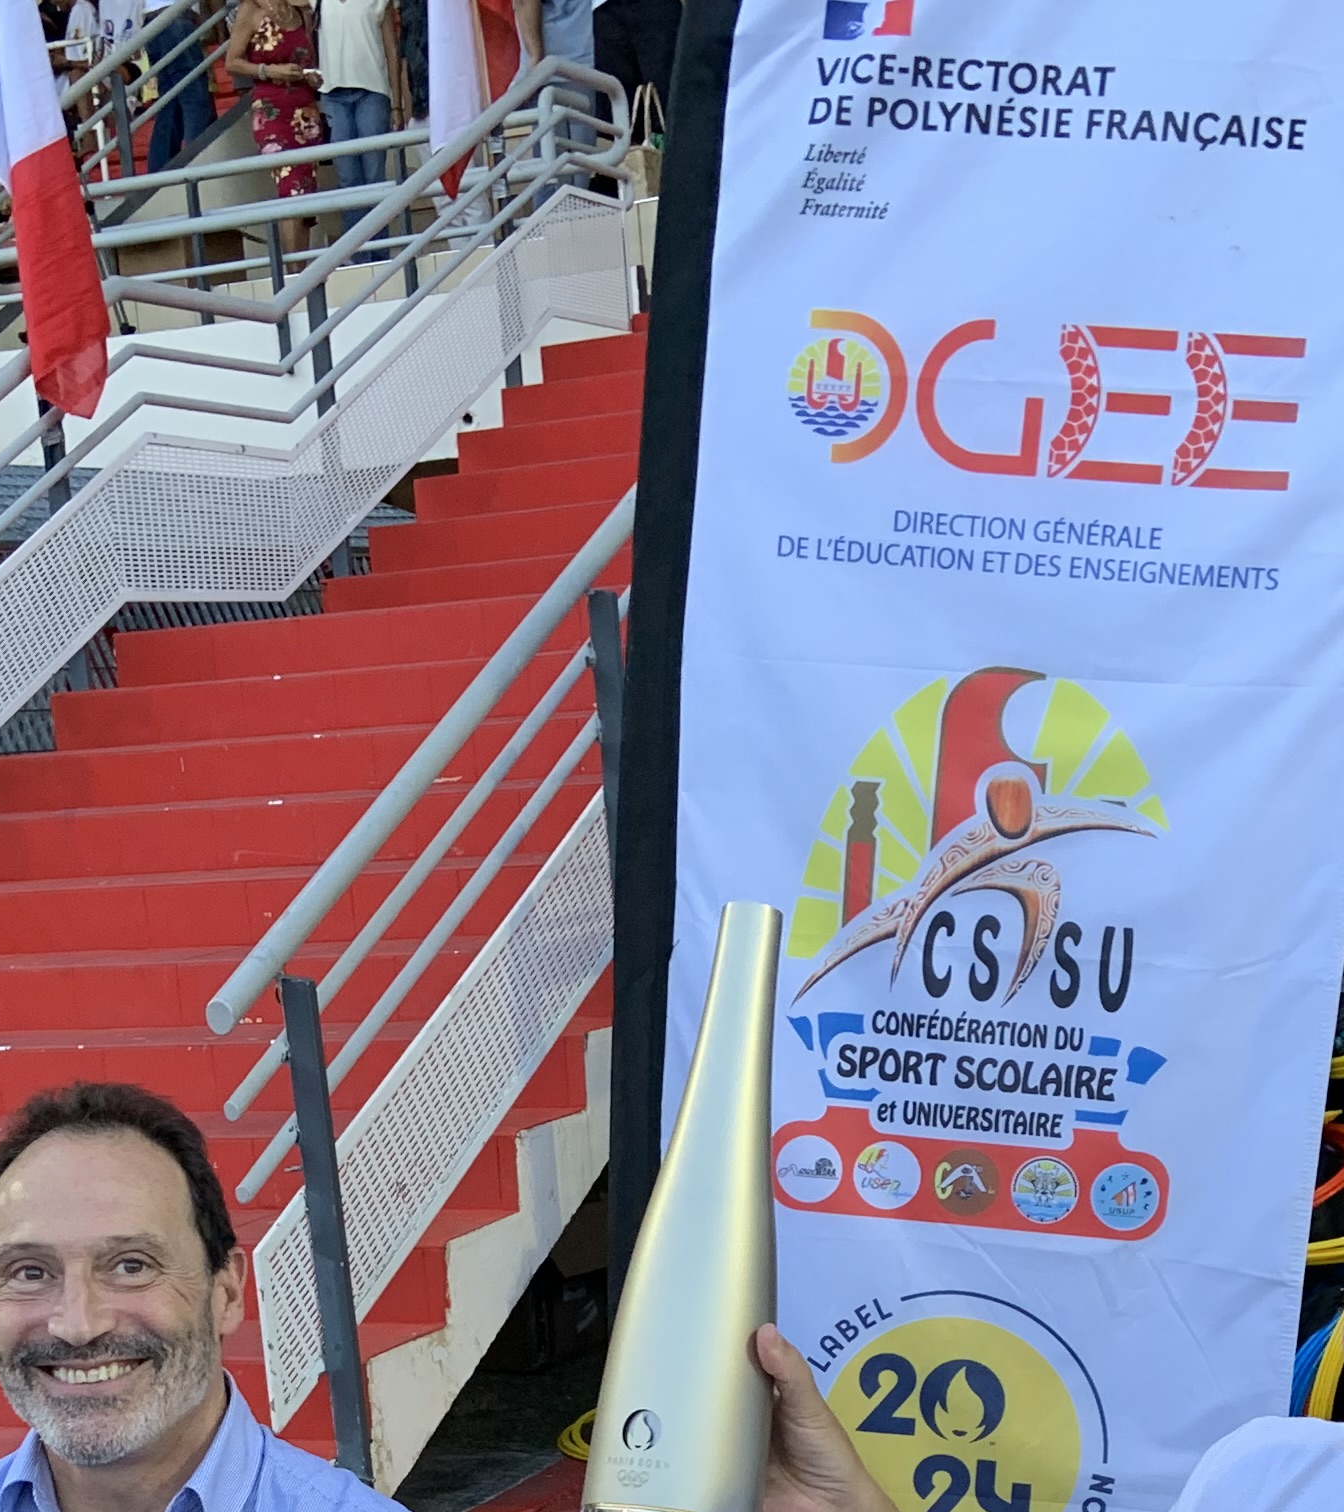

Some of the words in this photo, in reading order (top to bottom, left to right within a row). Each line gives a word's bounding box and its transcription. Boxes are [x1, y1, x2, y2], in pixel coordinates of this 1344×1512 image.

[817, 53, 1116, 97] VICE-RECTORAT
[808, 95, 854, 126] DE
[867, 97, 1073, 139] POLYNÉSIE
[1085, 108, 1307, 151] FRANÇAISE
[804, 143, 867, 165] Liberté
[801, 167, 867, 194] Égalité
[799, 198, 890, 220] Fraternité
[893, 510, 1026, 541] DIRECTION
[1033, 517, 1163, 550] GÉNÉRALE
[777, 535, 809, 559] DE
[816, 536, 974, 571] L'ÉDUCATION
[982, 550, 1011, 574] ET
[1014, 553, 1061, 577] DES
[1069, 557, 1280, 590] ENSEIGNEMENTS
[872, 1009, 1048, 1049] CONFÉDÉRATION
[1055, 1025, 1084, 1051] DU
[837, 1044, 946, 1086] SPORT
[955, 1056, 1118, 1101] SCOLAIRE
[877, 1101, 897, 1123] et
[903, 1101, 1064, 1138] UNIVERSITAIRE
[806, 1298, 893, 1372] LABEL
[857, 1353, 1005, 1443] 20
